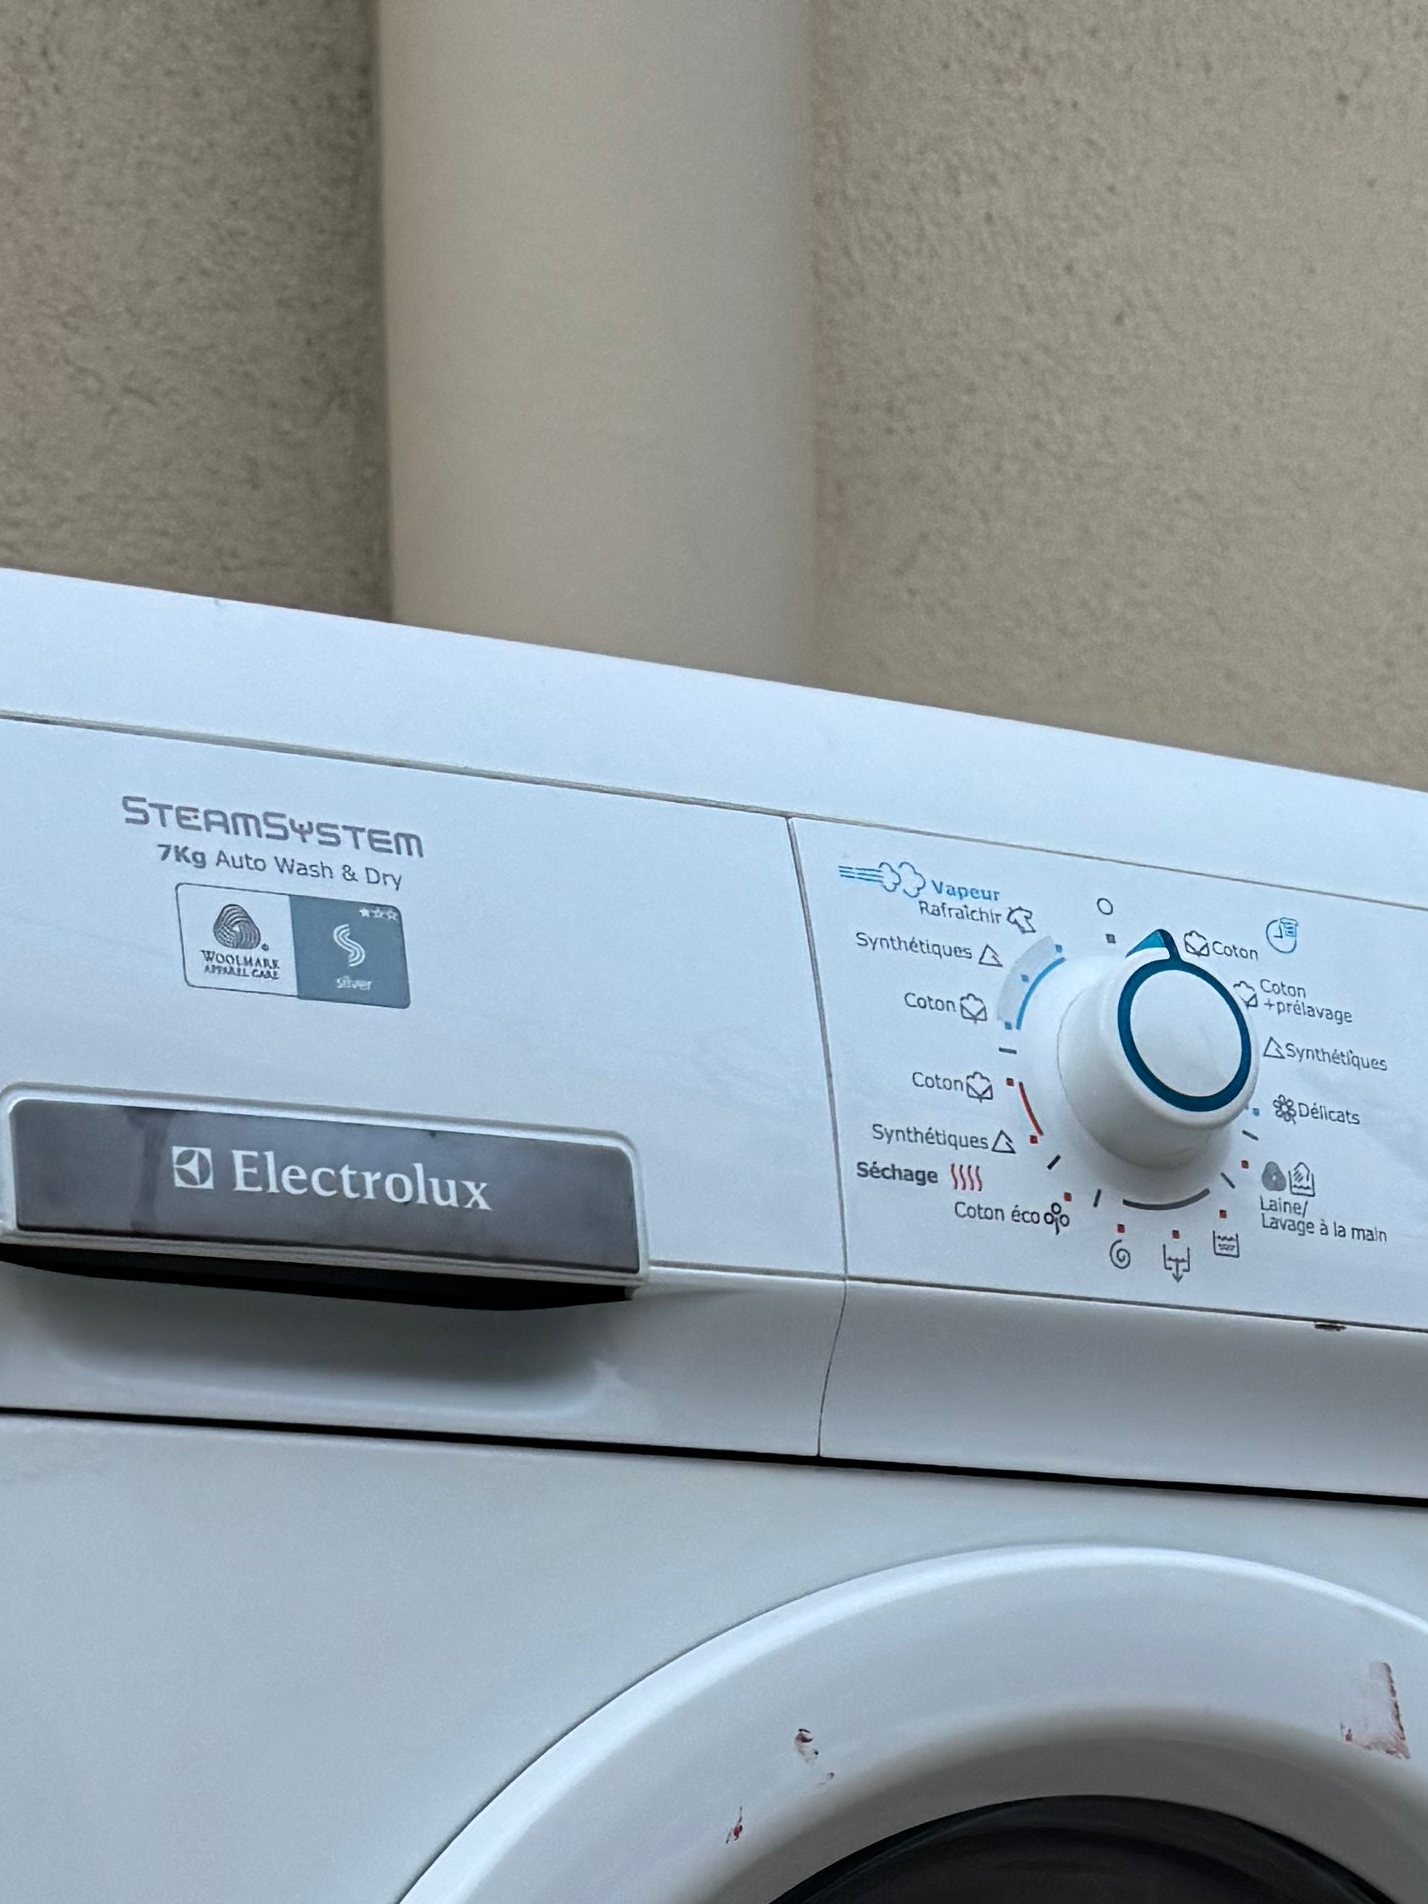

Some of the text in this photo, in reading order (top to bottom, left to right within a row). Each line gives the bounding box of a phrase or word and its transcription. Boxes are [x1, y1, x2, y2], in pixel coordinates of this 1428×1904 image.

[157, 843, 403, 891] 7Kg Auto Wash & Dry
[931, 879, 1000, 901] Vapeur
[919, 900, 1002, 924] Rafraîchir
[856, 932, 972, 959] Synthétiques
[1212, 939, 1259, 961] Coton
[200, 950, 280, 969] WOOLMARK
[252, 969, 279, 980] CARE
[1260, 978, 1306, 998] Coton
[904, 992, 956, 1013] Coton
[1263, 998, 1353, 1025] +prélavage
[1285, 1042, 1388, 1073] Synthétiques
[912, 1071, 964, 1094] Coton
[1297, 1102, 1361, 1125] Délicats
[872, 1124, 988, 1152] Synthétiques
[232, 1150, 493, 1211] Electrolux
[857, 1161, 939, 1187] Séchage
[954, 1201, 1041, 1224] Coton éco
[1260, 1196, 1308, 1217] Laine/
[1261, 1213, 1387, 1242] Lavage à la main
